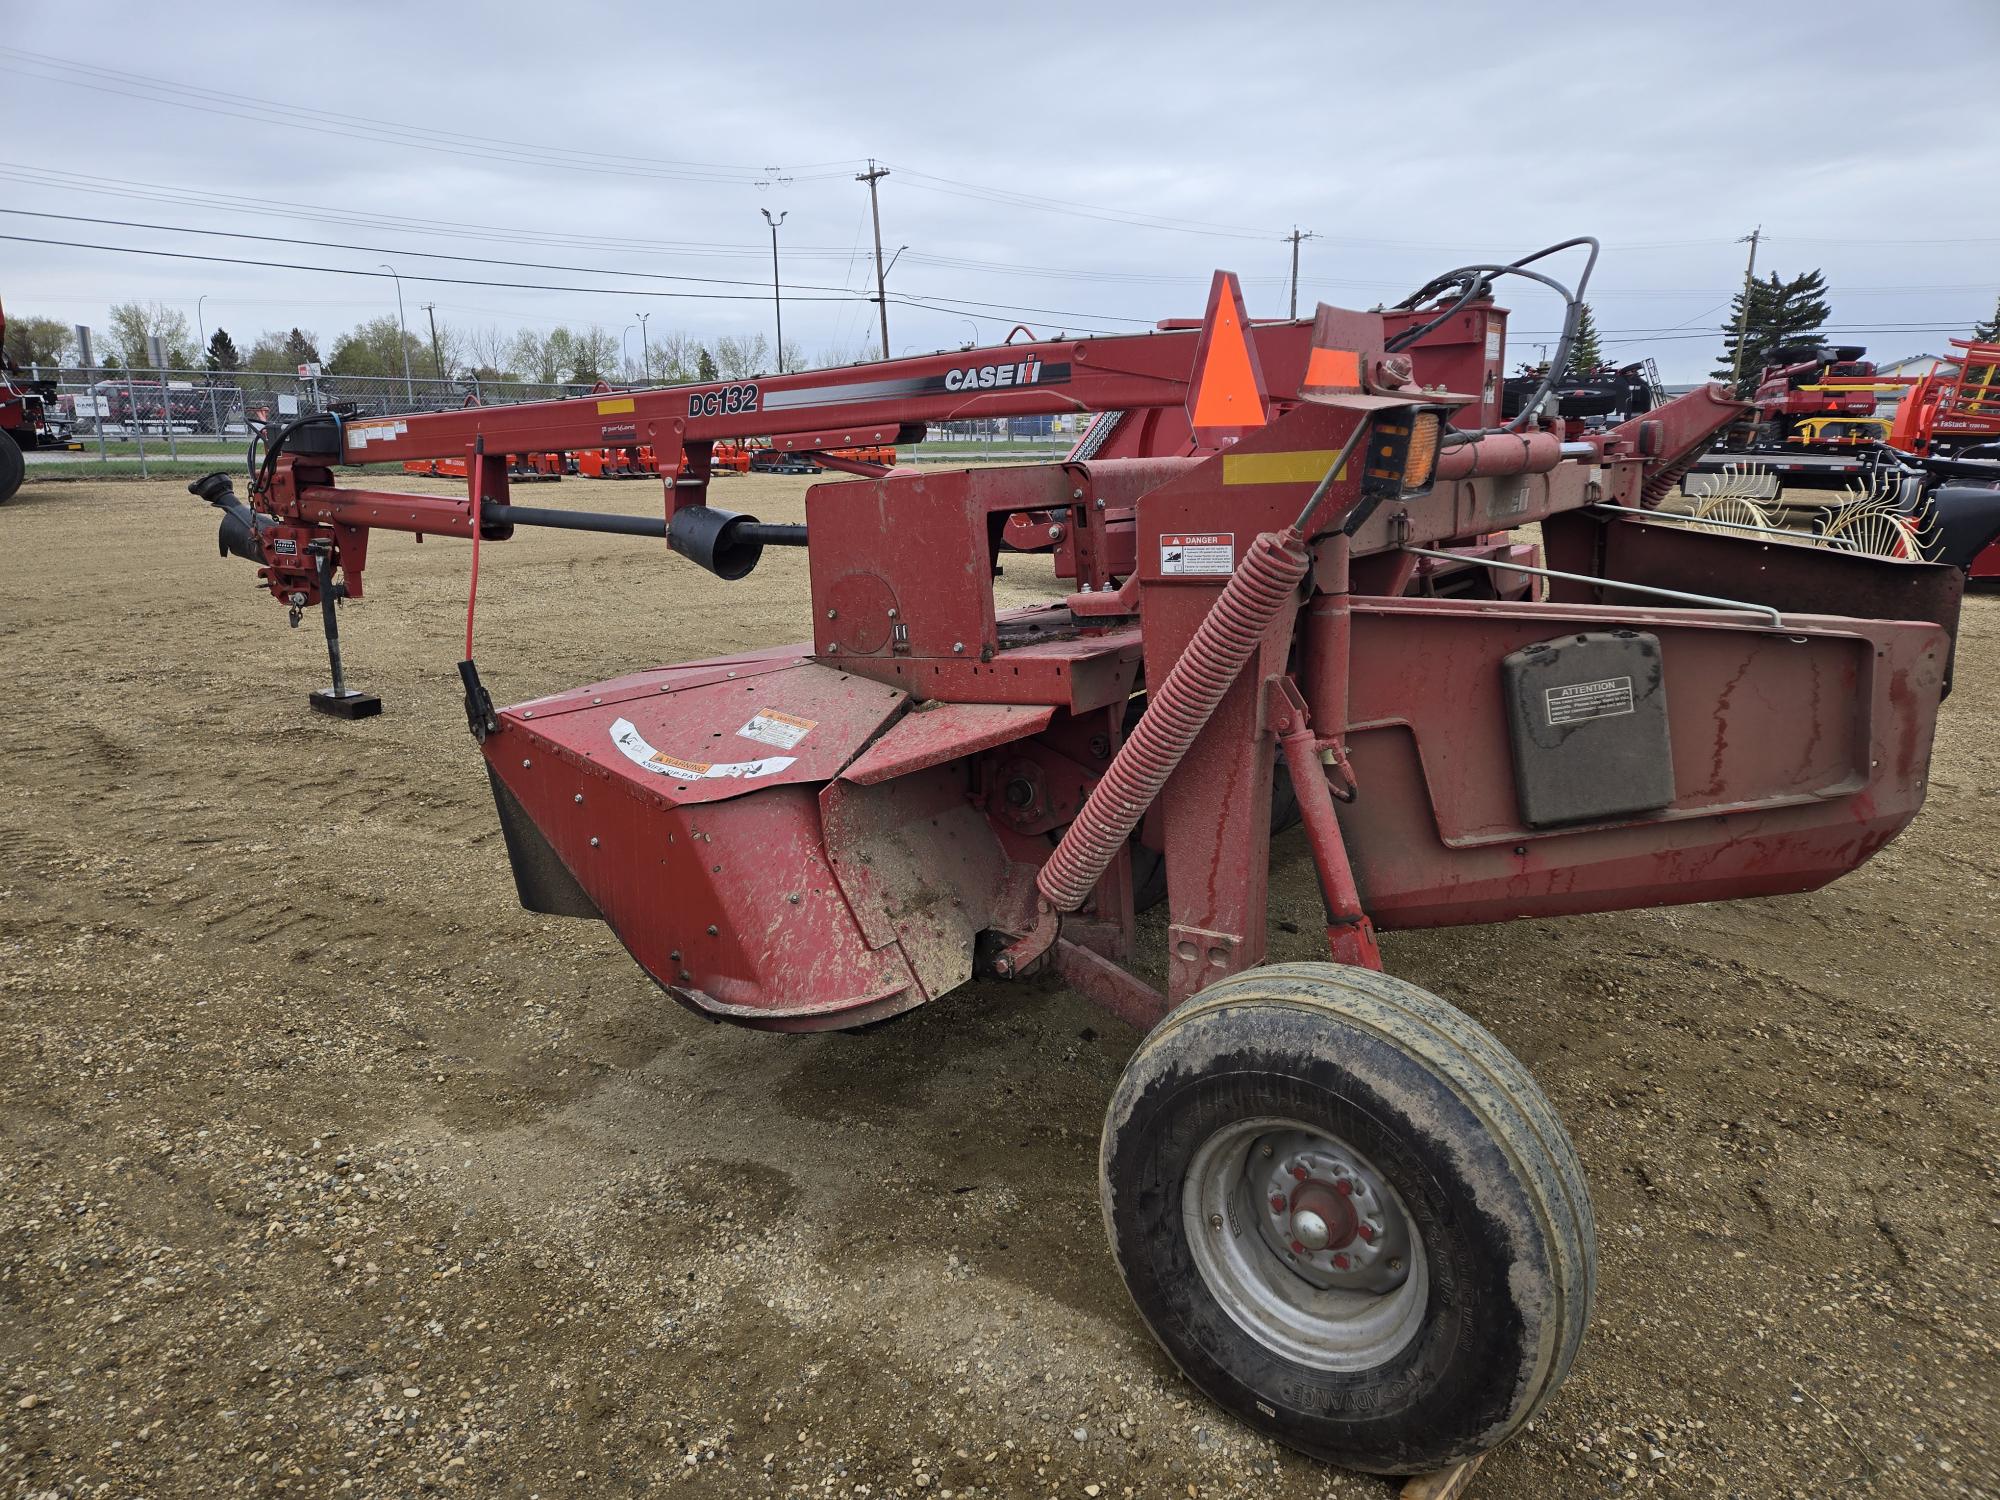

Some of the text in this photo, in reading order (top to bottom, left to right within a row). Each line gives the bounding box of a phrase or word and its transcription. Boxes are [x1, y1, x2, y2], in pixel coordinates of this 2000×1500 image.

[944, 363, 1015, 392] CASE
[688, 384, 759, 418] DC132
[1940, 420, 1967, 428] FaStack
[1185, 536, 1218, 544] DANGER
[1561, 681, 1616, 697] ATTENTION
[664, 756, 707, 773] WARNING
